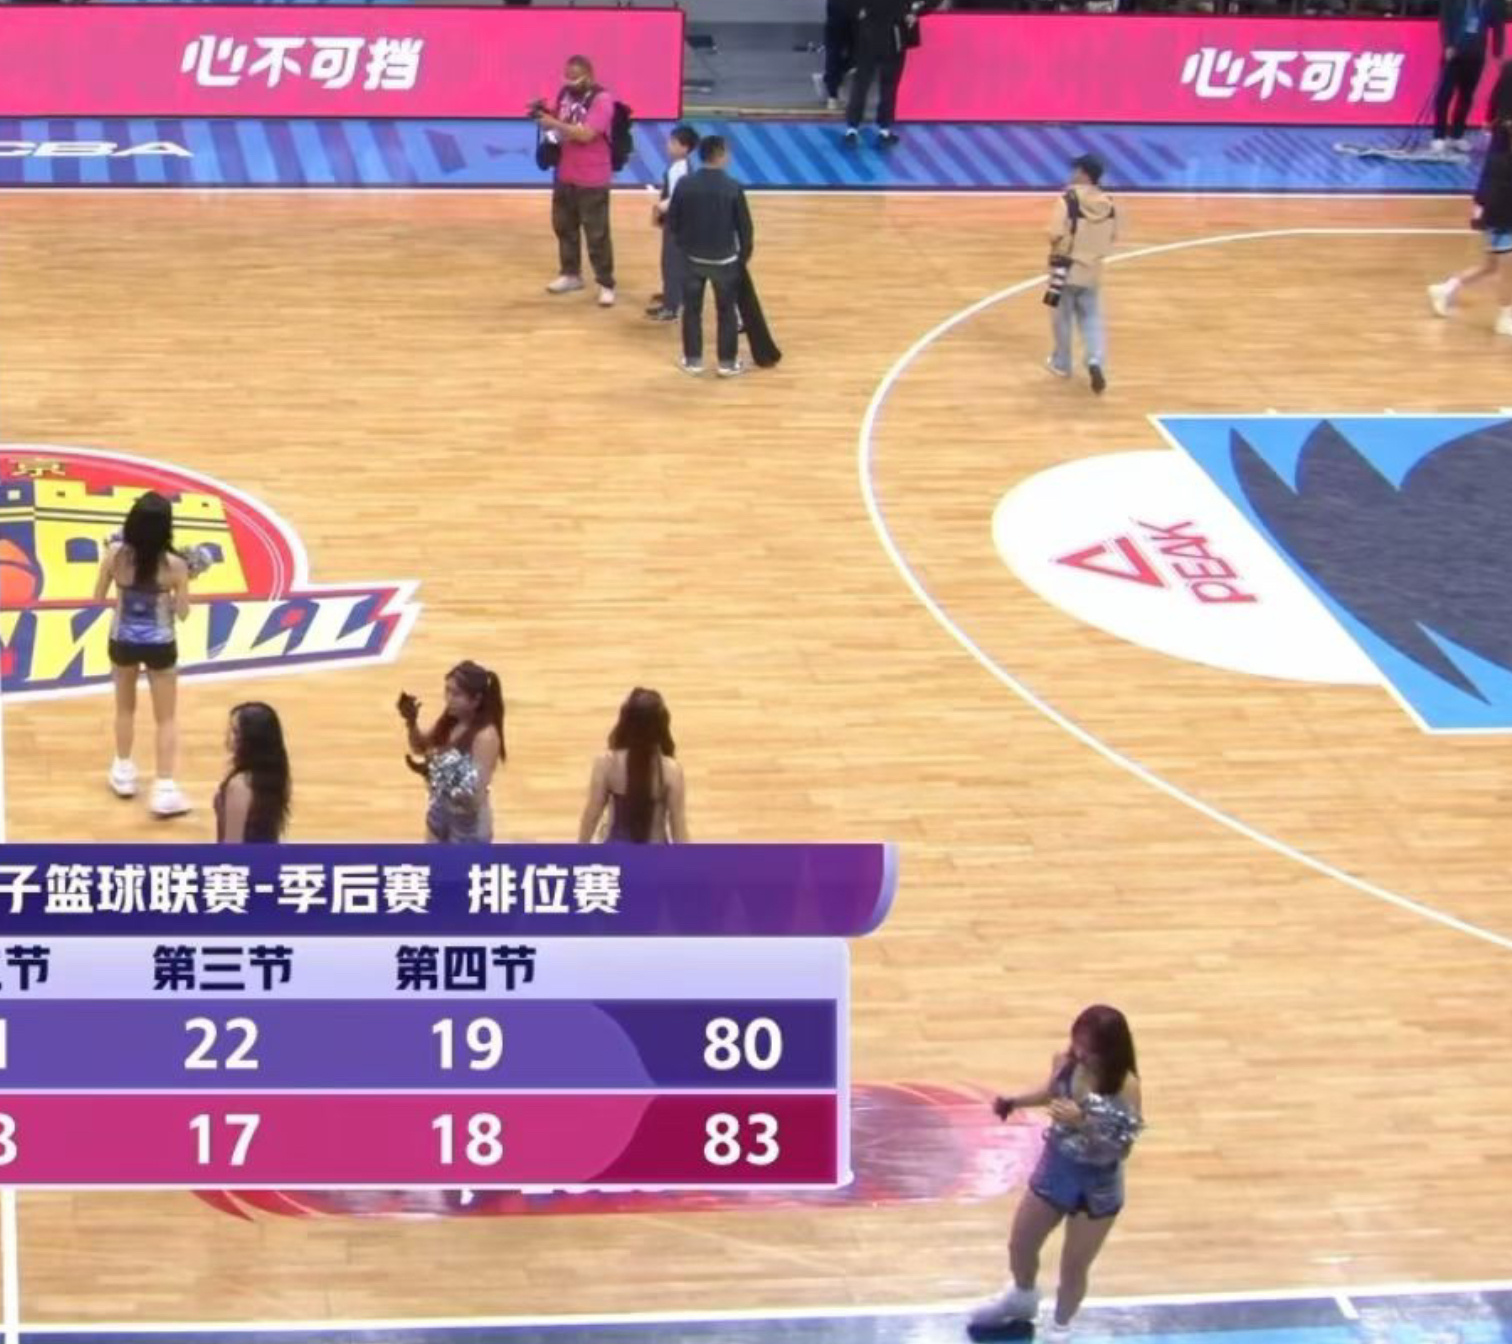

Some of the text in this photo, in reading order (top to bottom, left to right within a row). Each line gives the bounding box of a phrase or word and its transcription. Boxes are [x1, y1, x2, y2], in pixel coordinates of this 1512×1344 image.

[181, 35, 425, 90] 心不可挡
[1180, 47, 1406, 103] 心不可挡
[1136, 519, 1258, 603] PEAK
